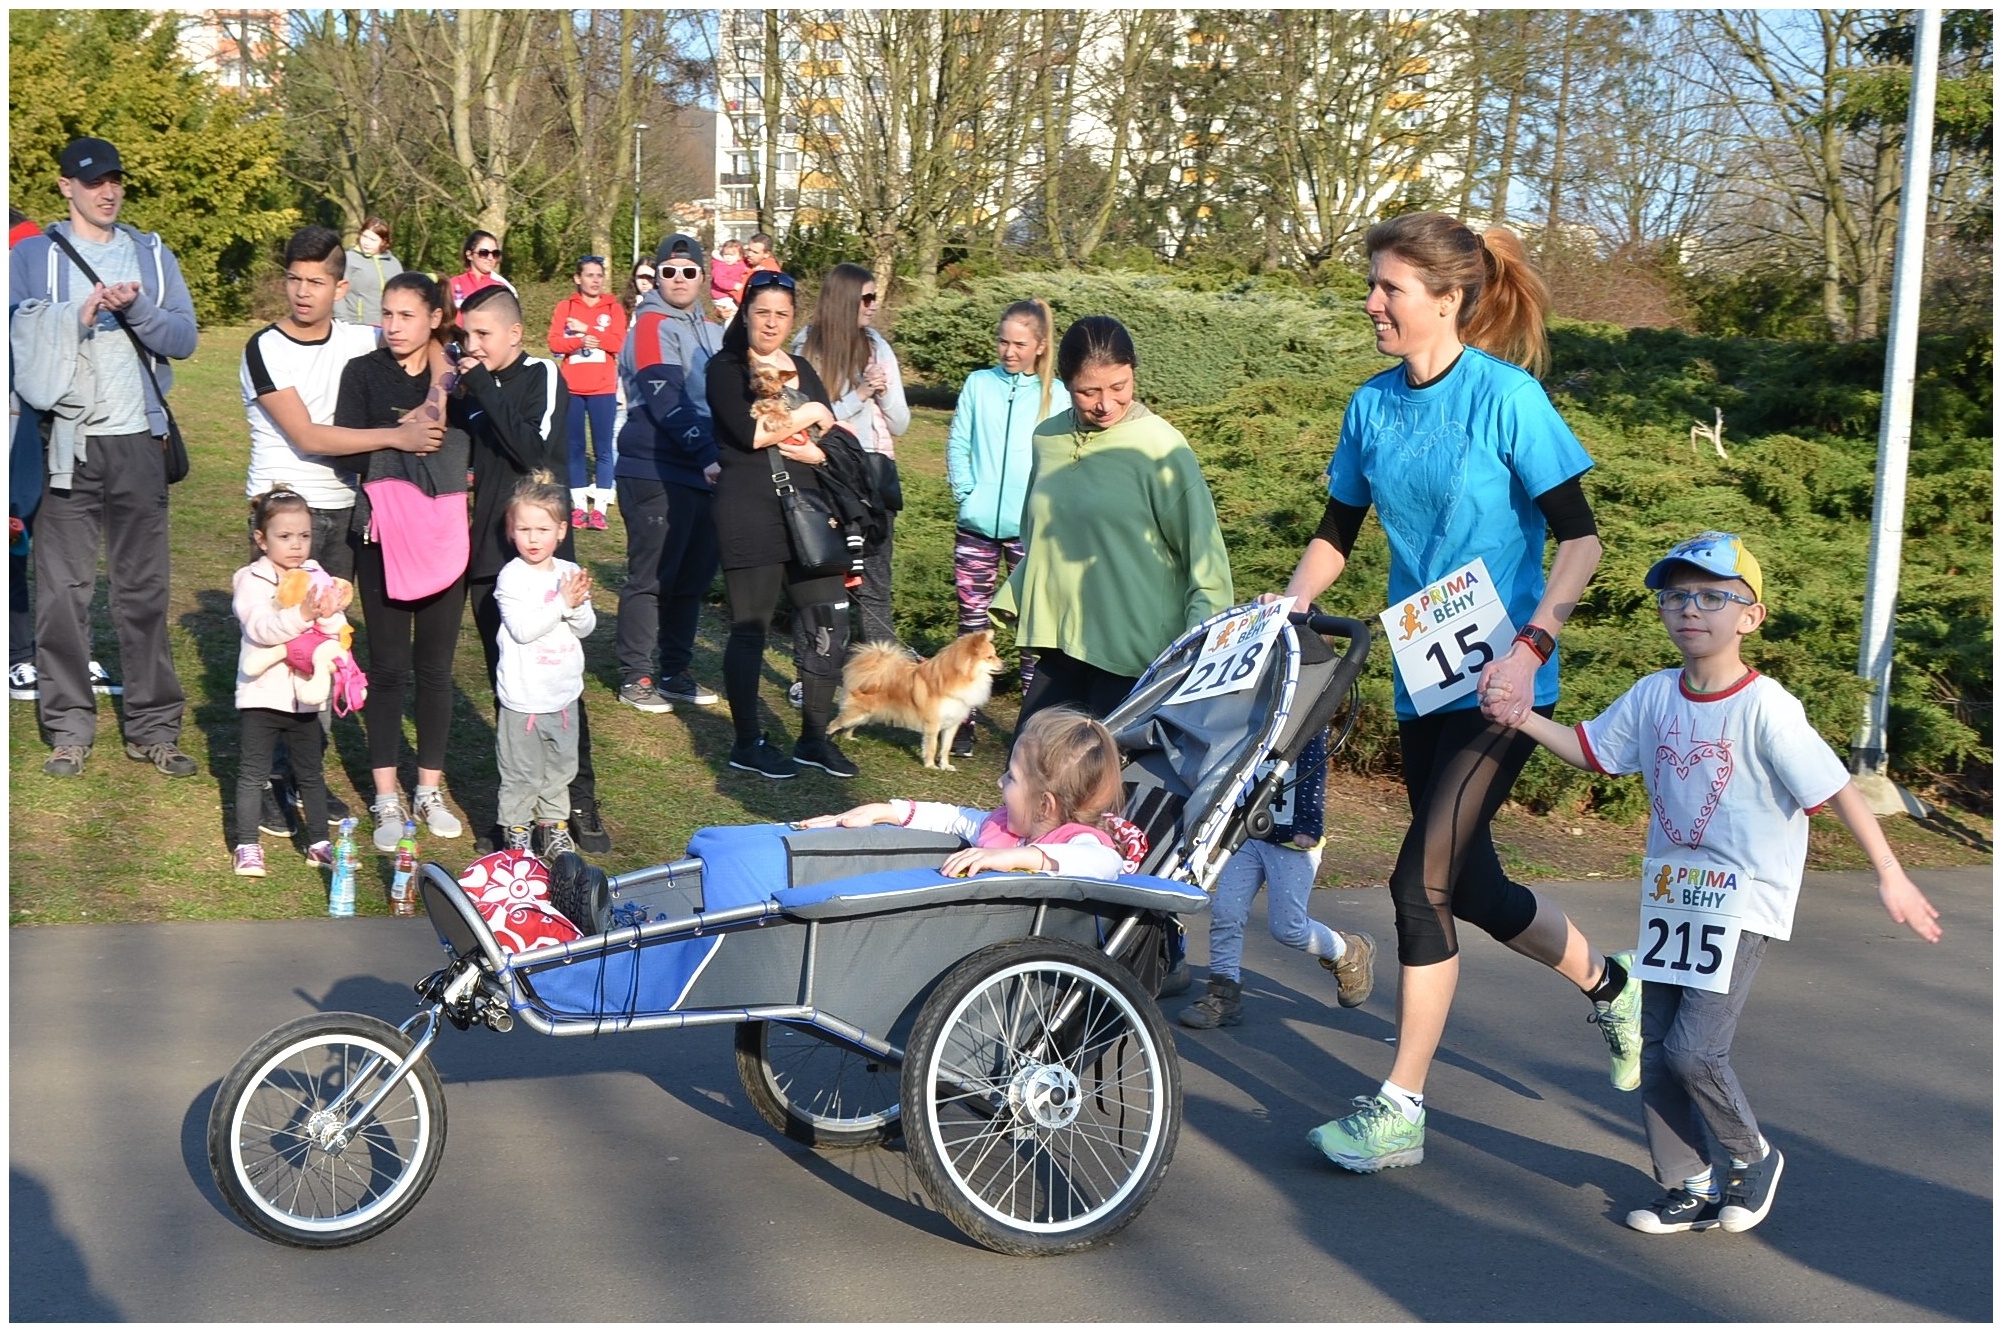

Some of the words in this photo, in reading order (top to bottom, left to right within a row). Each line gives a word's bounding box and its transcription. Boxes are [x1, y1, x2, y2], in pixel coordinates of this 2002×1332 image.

[647, 380, 700, 444] AIR
[1420, 571, 1478, 611] PRIMA
[1433, 591, 1476, 624] BĚHY
[1238, 603, 1281, 631] PRIMA
[1179, 642, 1264, 696] 218
[1425, 623, 1494, 690] 15
[1653, 714, 1735, 746] VALI
[1676, 867, 1737, 890] PRIMA
[1682, 885, 1726, 908] BĚHY
[1642, 918, 1726, 974] 215
